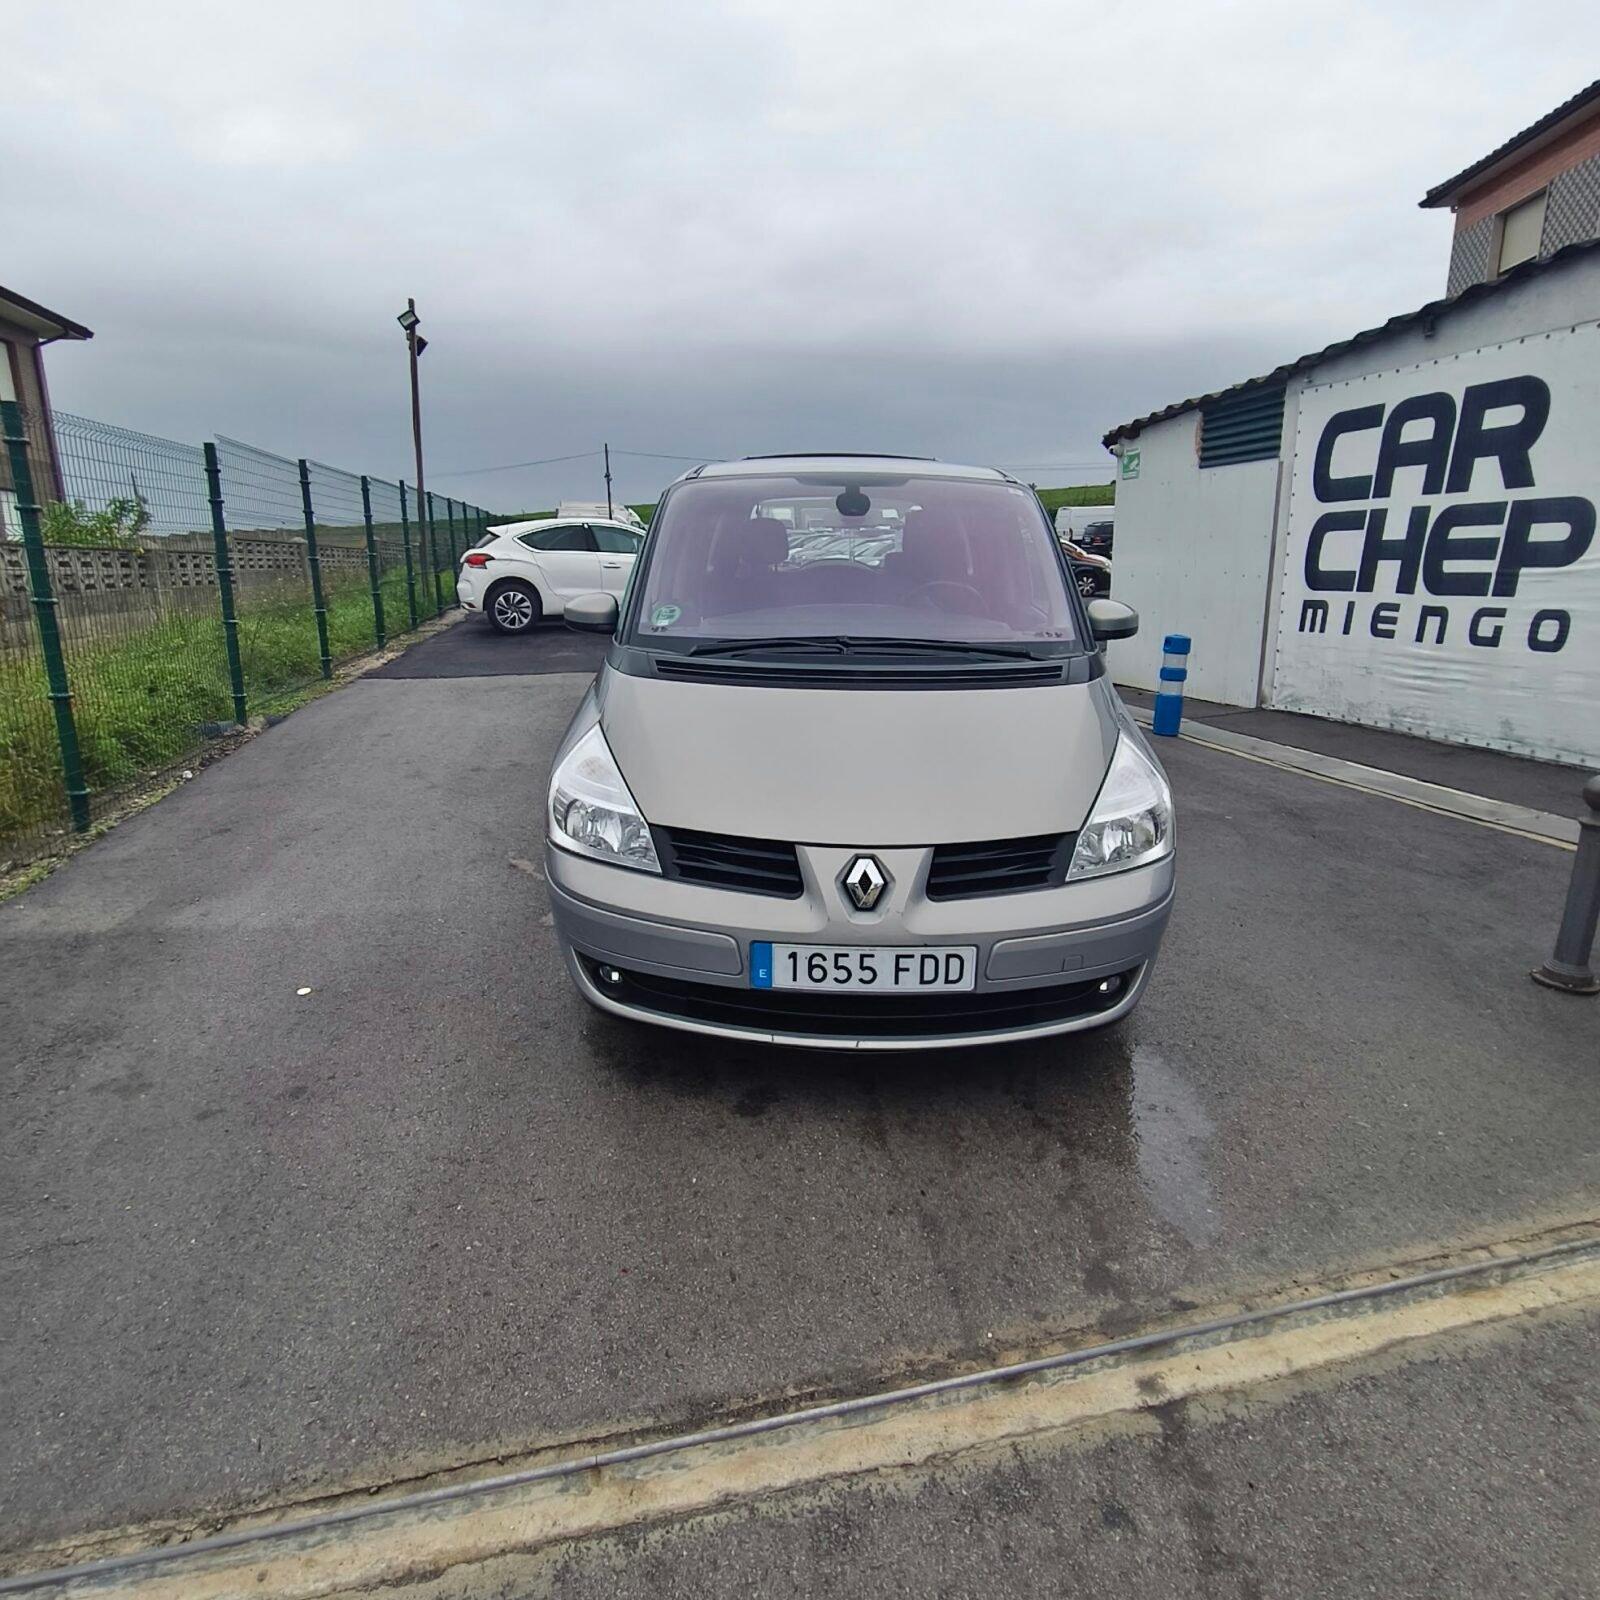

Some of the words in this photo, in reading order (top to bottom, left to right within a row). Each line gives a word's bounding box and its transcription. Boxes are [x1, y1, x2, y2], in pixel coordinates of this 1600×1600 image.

[1313, 375, 1551, 503] CAR
[1305, 496, 1597, 597] CHEP
[1299, 600, 1571, 653] MIENGO
[759, 969, 767, 978] E
[788, 951, 878, 984] 1655
[894, 953, 965, 985] FDD
